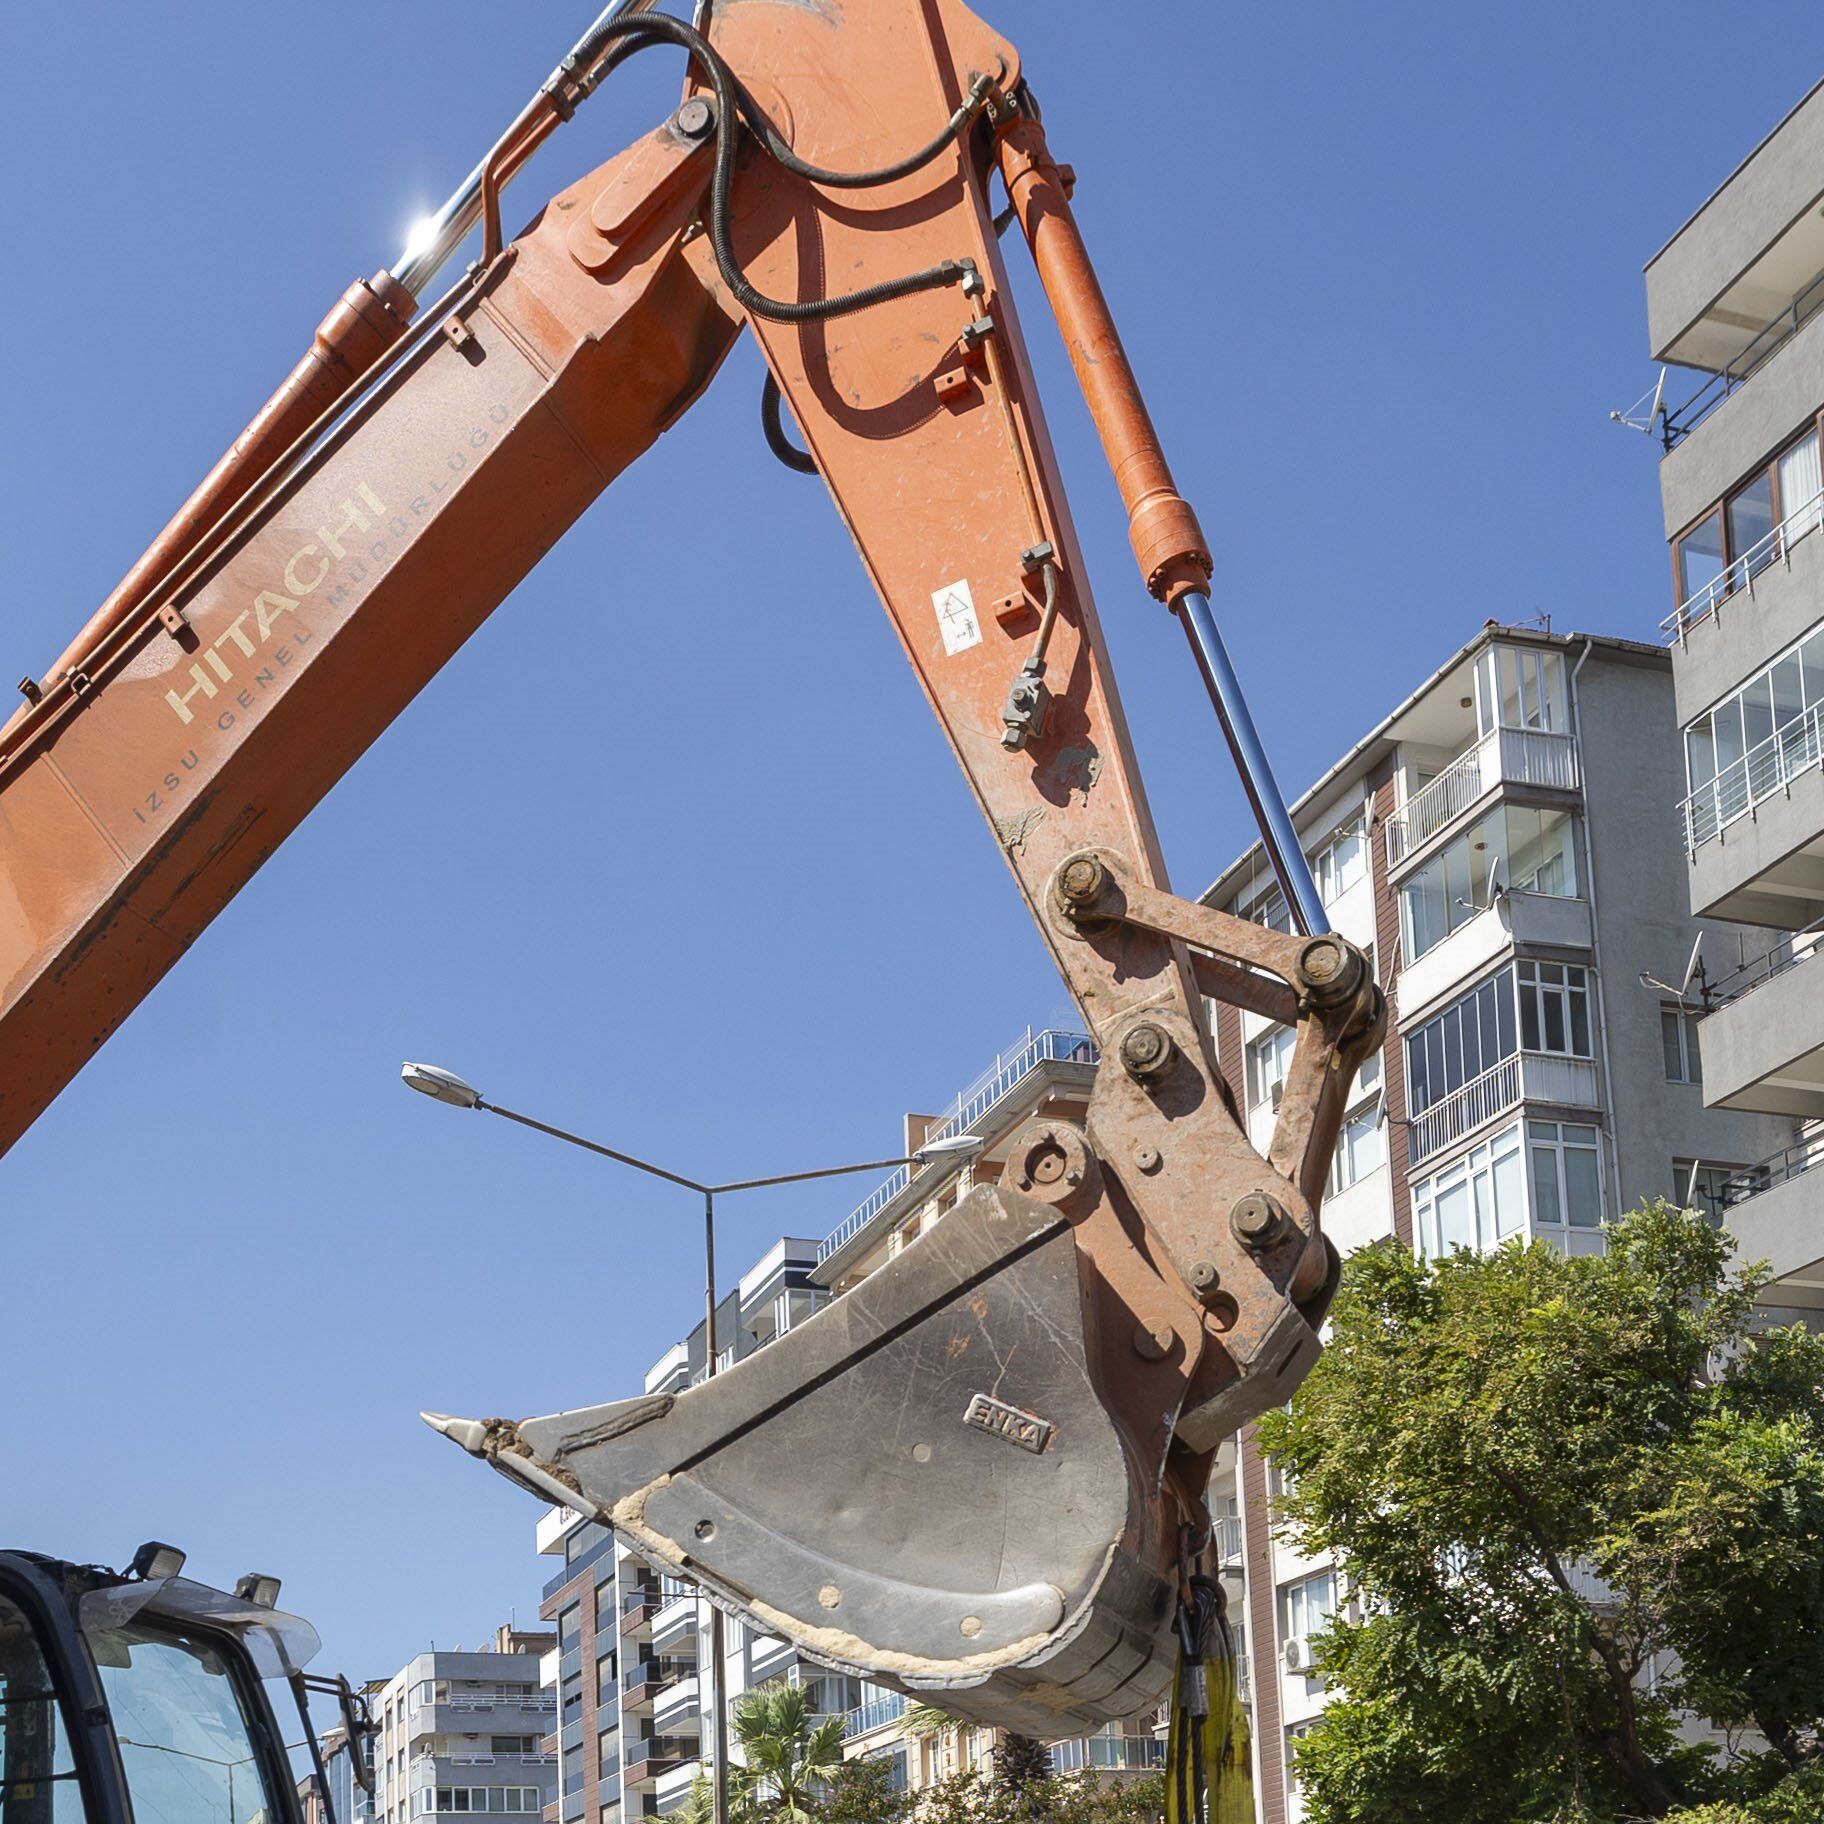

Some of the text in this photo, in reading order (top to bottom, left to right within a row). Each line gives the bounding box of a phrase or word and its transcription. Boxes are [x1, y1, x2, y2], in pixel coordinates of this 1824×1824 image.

[165, 481, 387, 725] HITACHI
[217, 631, 312, 731] GENEL
[971, 1399, 1045, 1447] ENKA
